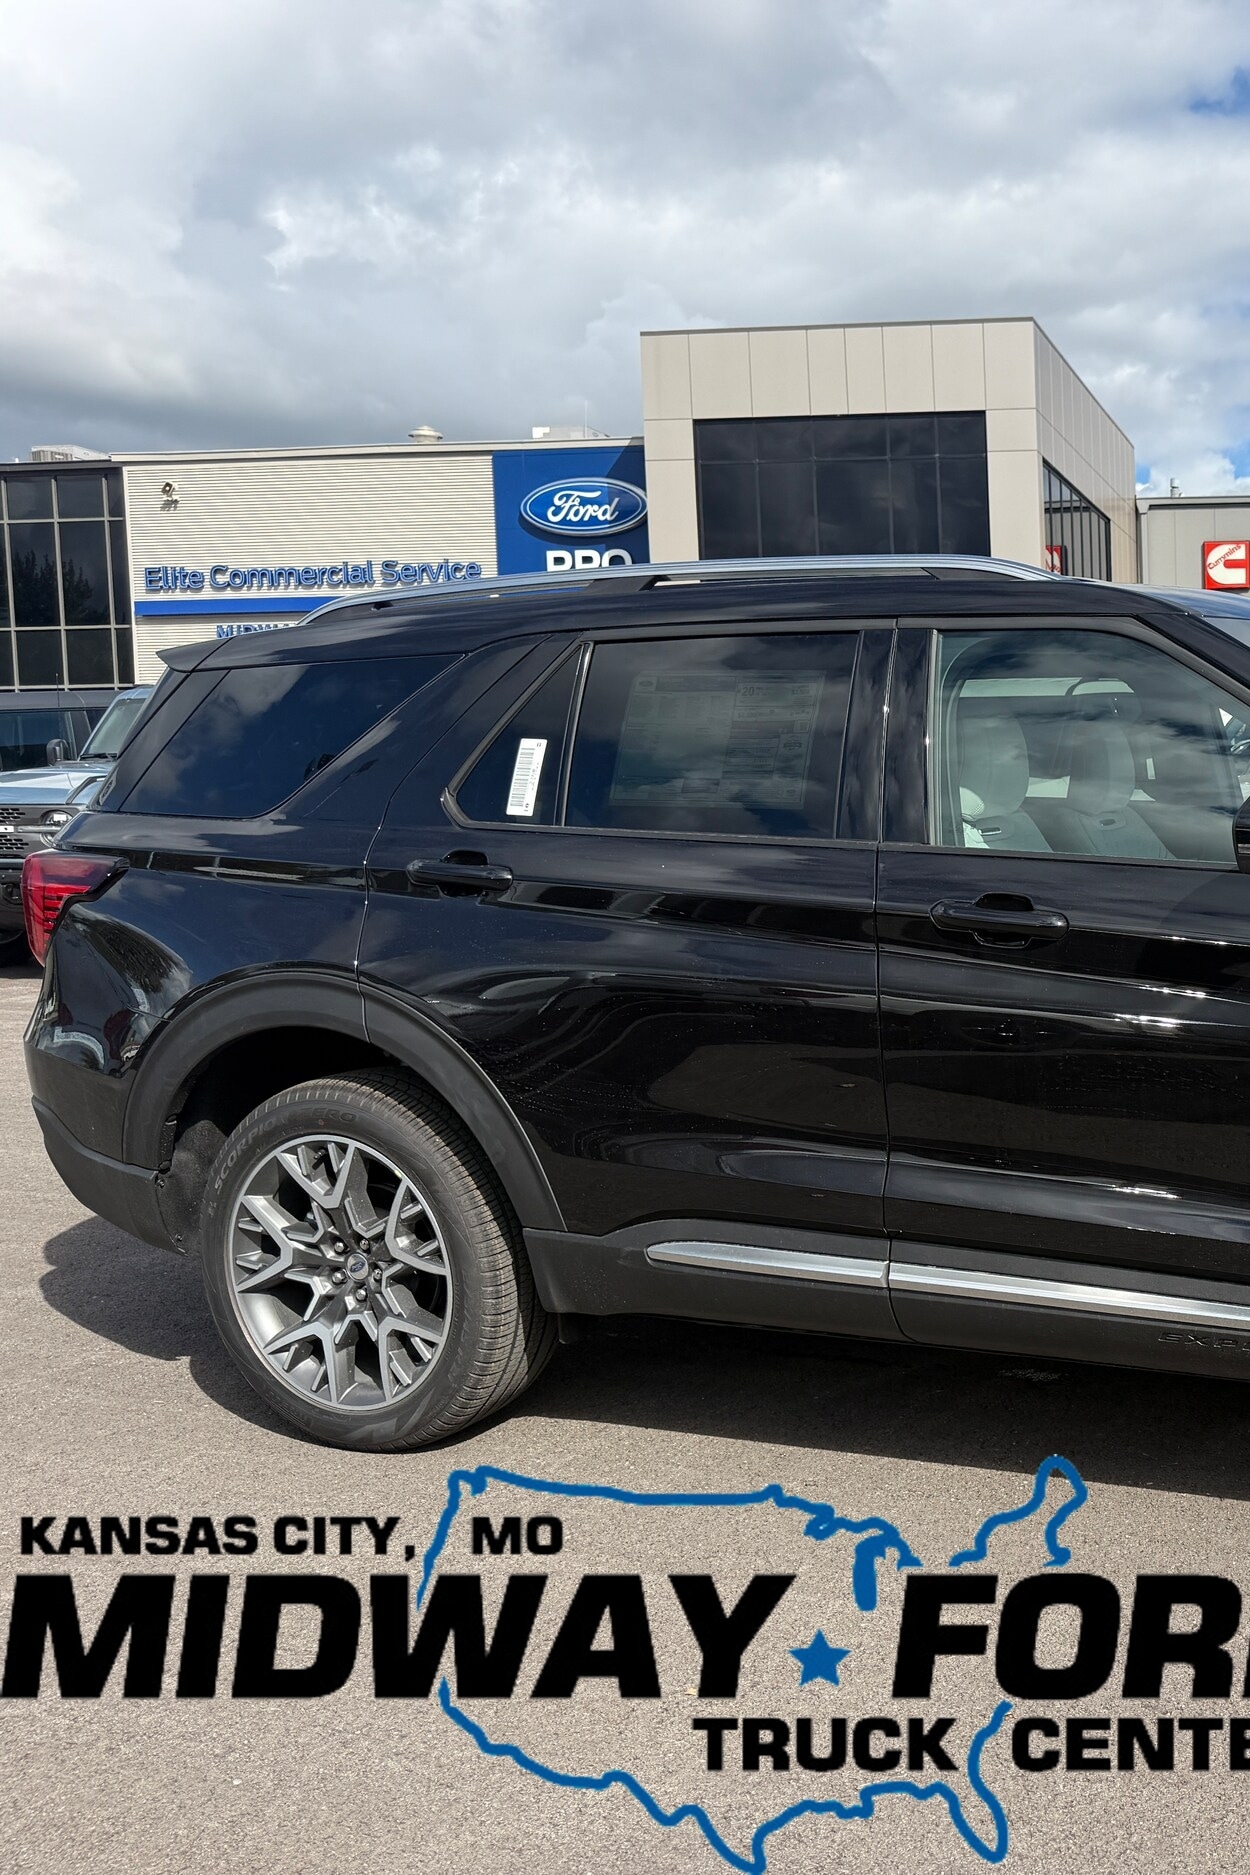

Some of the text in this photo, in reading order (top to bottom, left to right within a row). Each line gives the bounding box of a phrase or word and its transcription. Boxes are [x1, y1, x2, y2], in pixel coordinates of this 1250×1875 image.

[547, 490, 620, 522] Ford
[1207, 544, 1242, 570] Cummins
[144, 558, 482, 589] Elite Commercial Service
